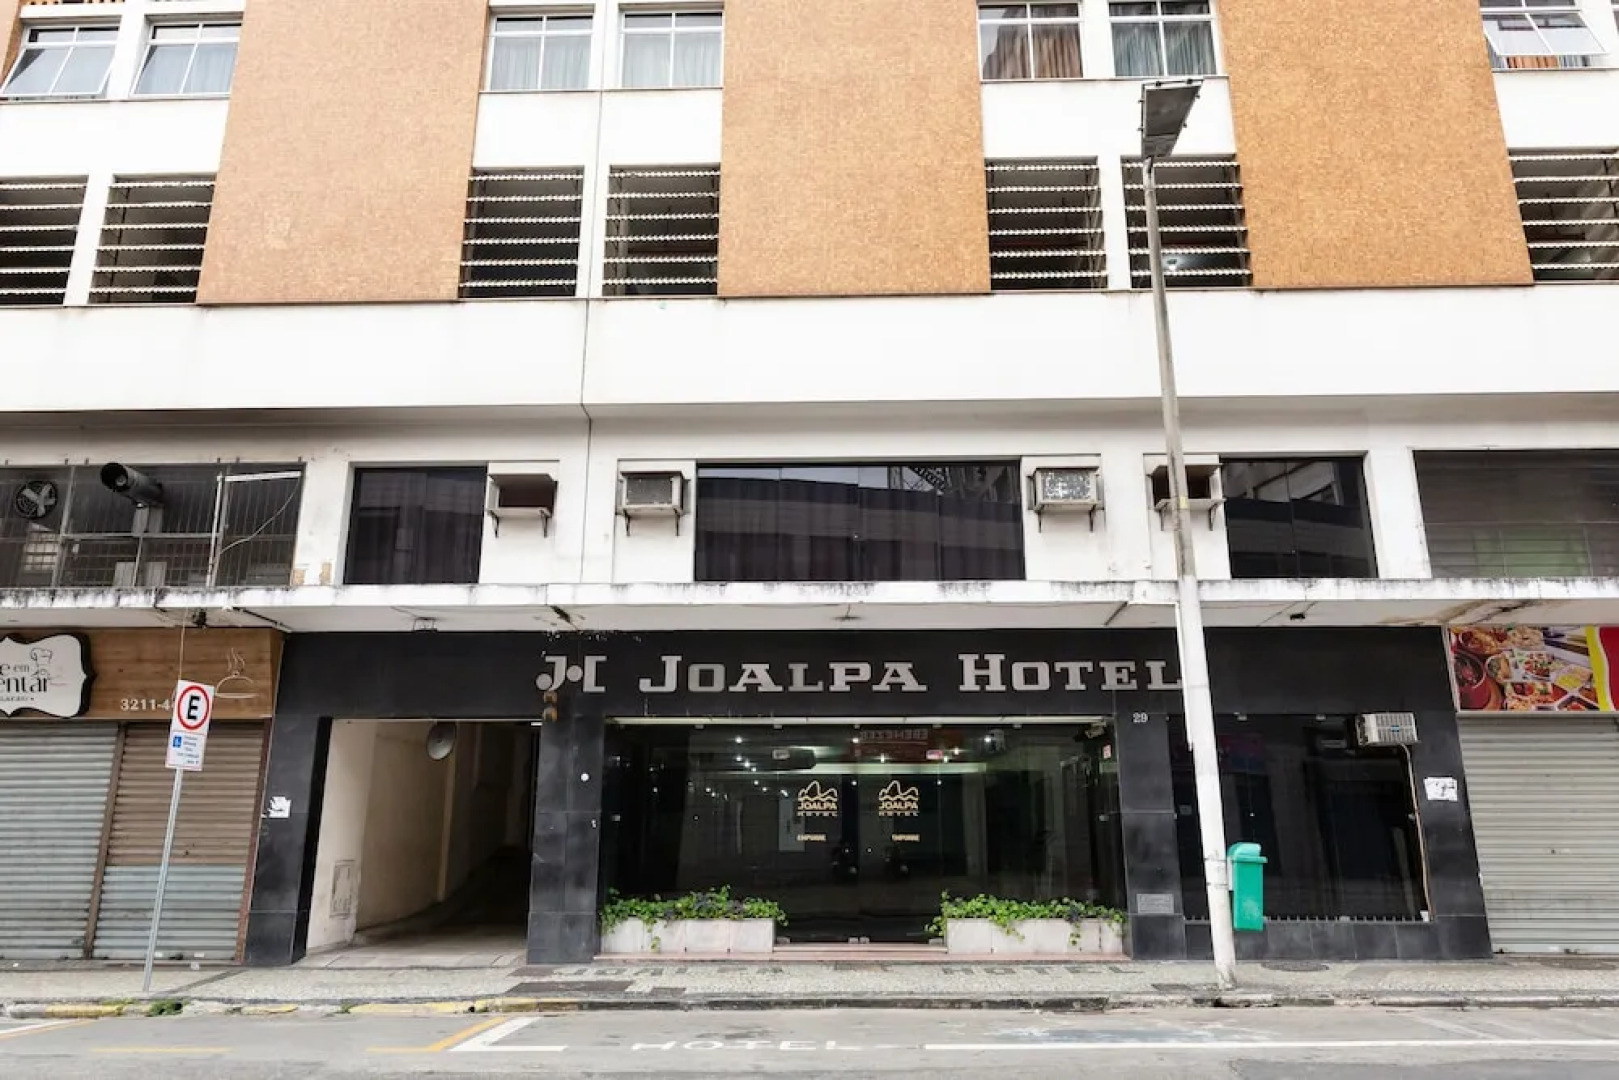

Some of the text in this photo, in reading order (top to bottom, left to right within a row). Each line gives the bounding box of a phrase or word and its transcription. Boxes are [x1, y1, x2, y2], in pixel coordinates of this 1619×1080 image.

[638, 653, 1183, 693] JOALPA HOTEL
[120, 698, 174, 711] 3211-4
[187, 695, 201, 720] E
[797, 801, 838, 810] JOALPA
[879, 801, 919, 810] JOALPA
[631, 1040, 864, 1051] HOTEL
